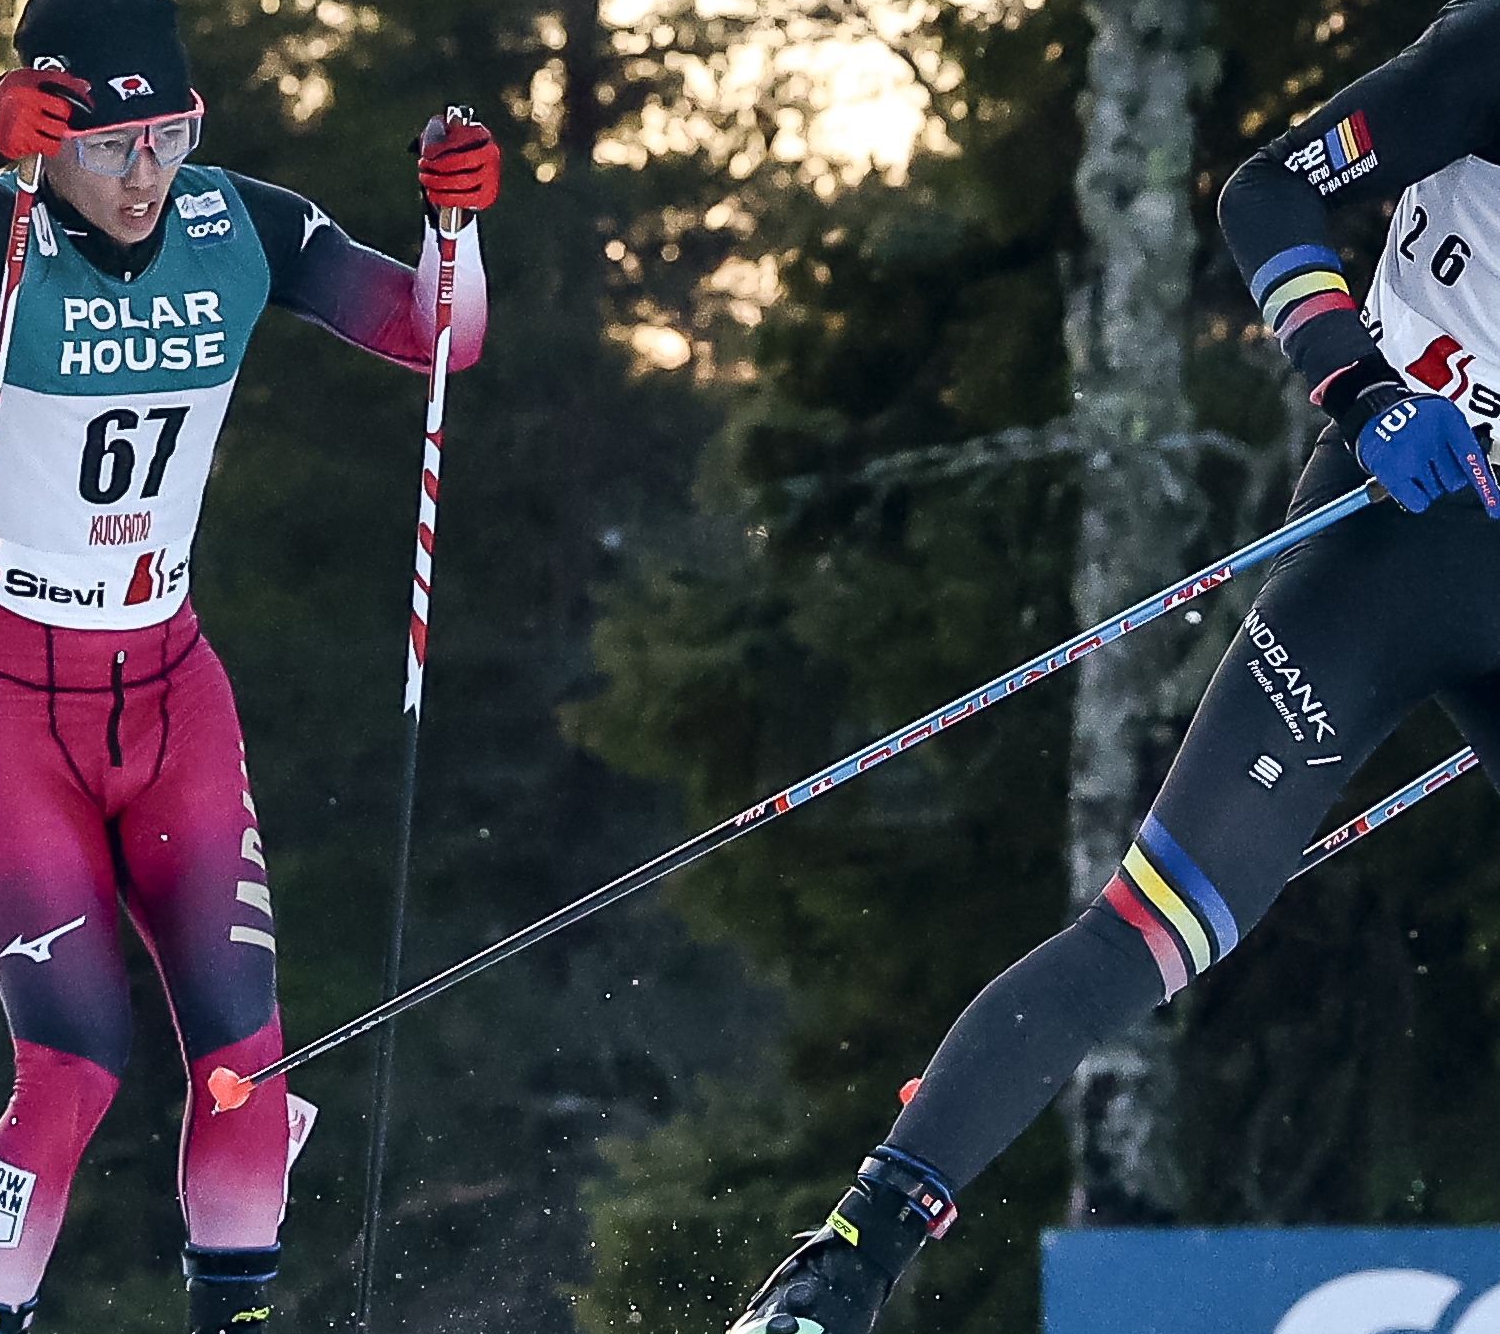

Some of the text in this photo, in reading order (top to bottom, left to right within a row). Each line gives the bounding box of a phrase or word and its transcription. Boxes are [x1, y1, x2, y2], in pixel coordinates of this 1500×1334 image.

[186, 219, 231, 238] coop
[63, 290, 224, 331] POLAR
[60, 331, 225, 375] HOUSE
[78, 405, 191, 505] 67
[88, 510, 152, 546] KUUSAMO
[4, 568, 106, 608] Sievi
[1247, 658, 1305, 742] Private Bankers
